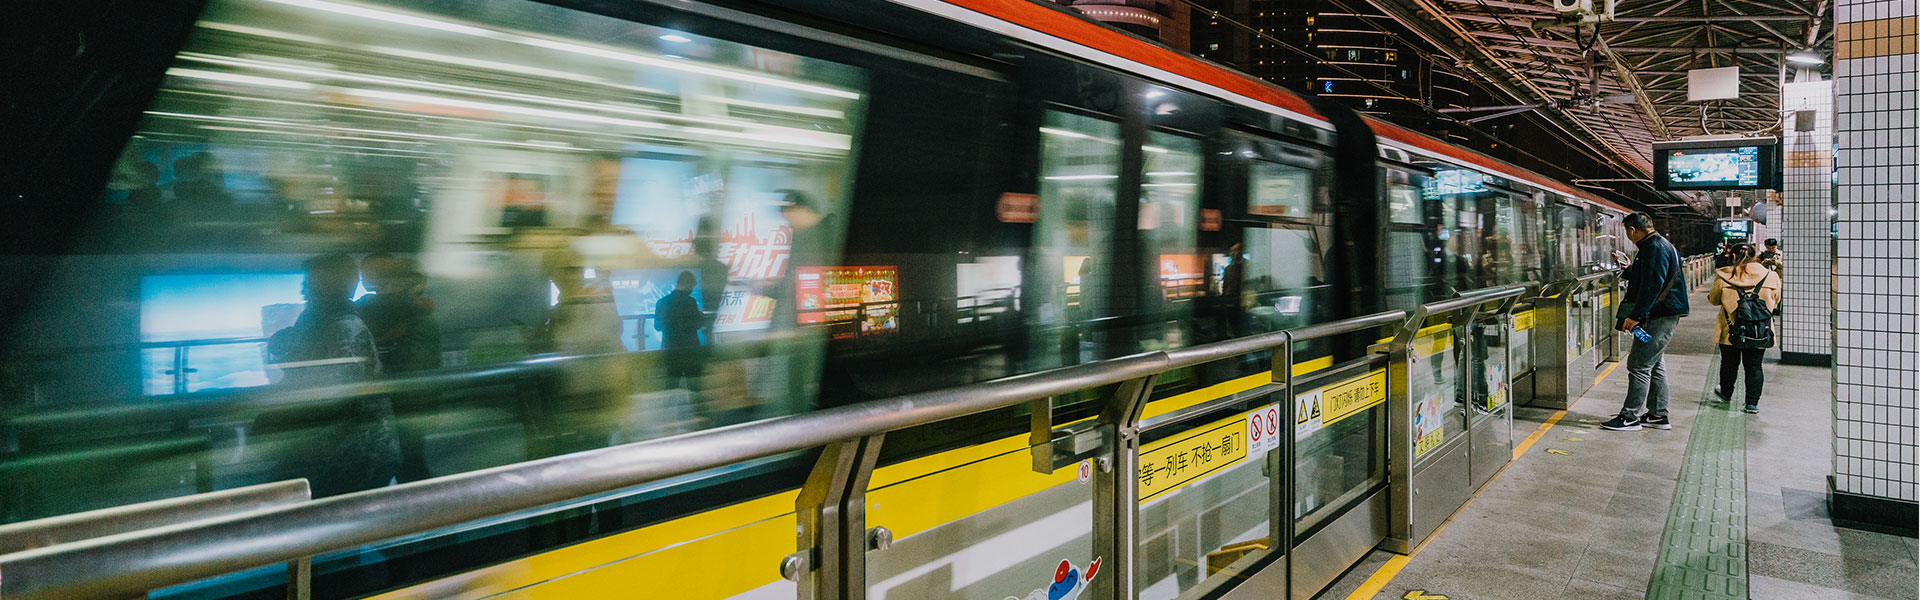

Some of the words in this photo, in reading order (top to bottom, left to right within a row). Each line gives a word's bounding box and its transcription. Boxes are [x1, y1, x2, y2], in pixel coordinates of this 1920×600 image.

[747, 296, 776, 319] 体
[1354, 382, 1380, 403] 请勿上下车
[1139, 450, 1188, 487] 等一列车
[1191, 431, 1240, 468] 不抢一扇门
[1080, 464, 1089, 479] 10
